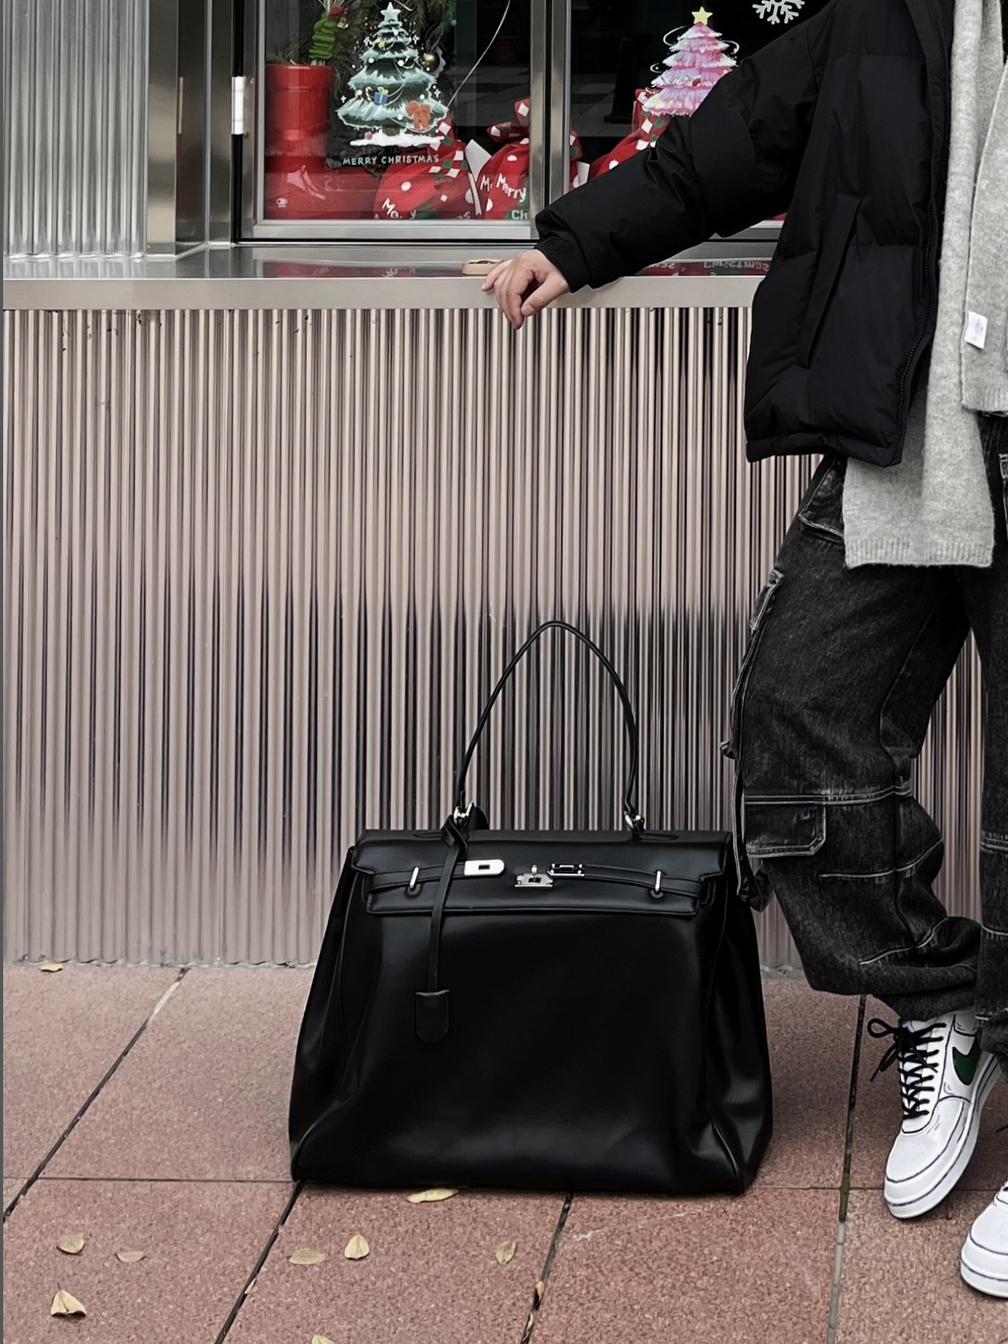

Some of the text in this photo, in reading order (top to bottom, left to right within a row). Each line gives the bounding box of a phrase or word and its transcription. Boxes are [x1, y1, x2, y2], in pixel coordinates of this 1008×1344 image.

[342, 154, 440, 166] MERRY CHRISTMAS
[495, 172, 527, 203] Merry
